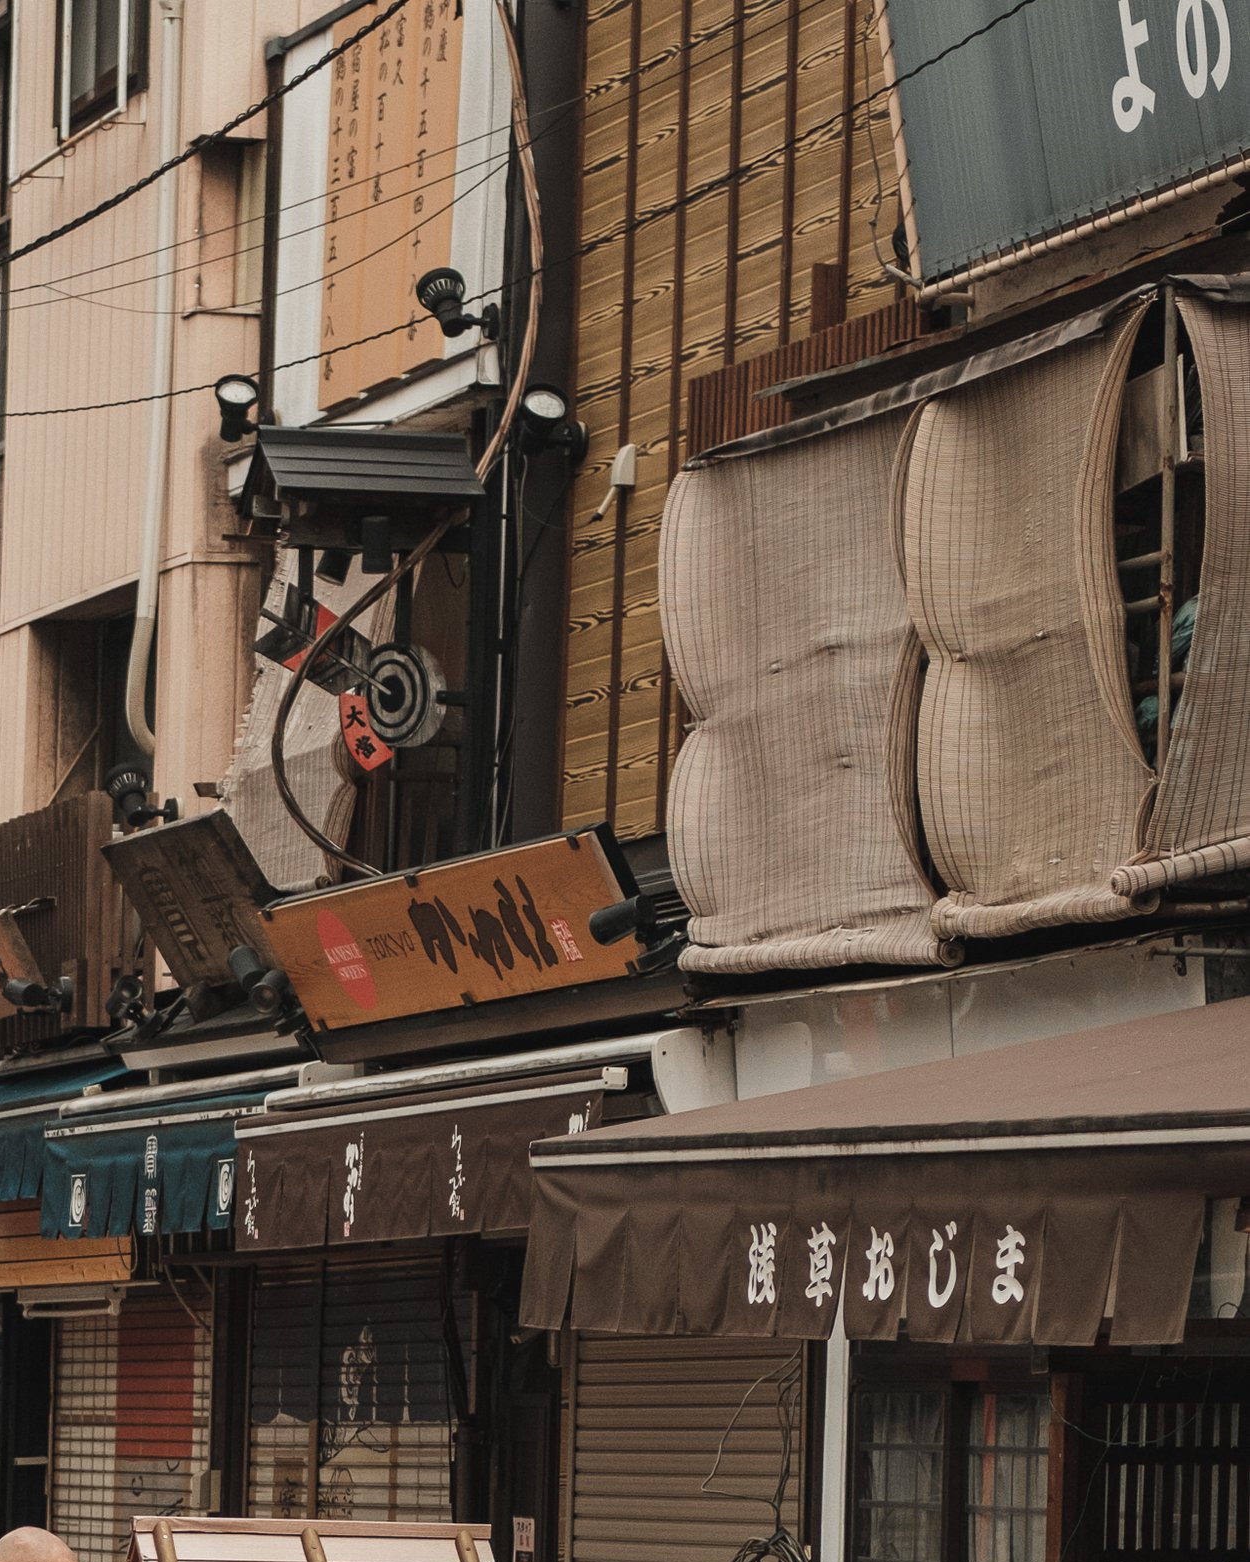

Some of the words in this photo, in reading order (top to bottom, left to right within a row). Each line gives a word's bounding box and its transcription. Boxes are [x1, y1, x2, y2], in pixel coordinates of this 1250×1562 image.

[366, 930, 415, 961] TOKYO
[747, 1219, 1026, 1309] 浅草おじま
